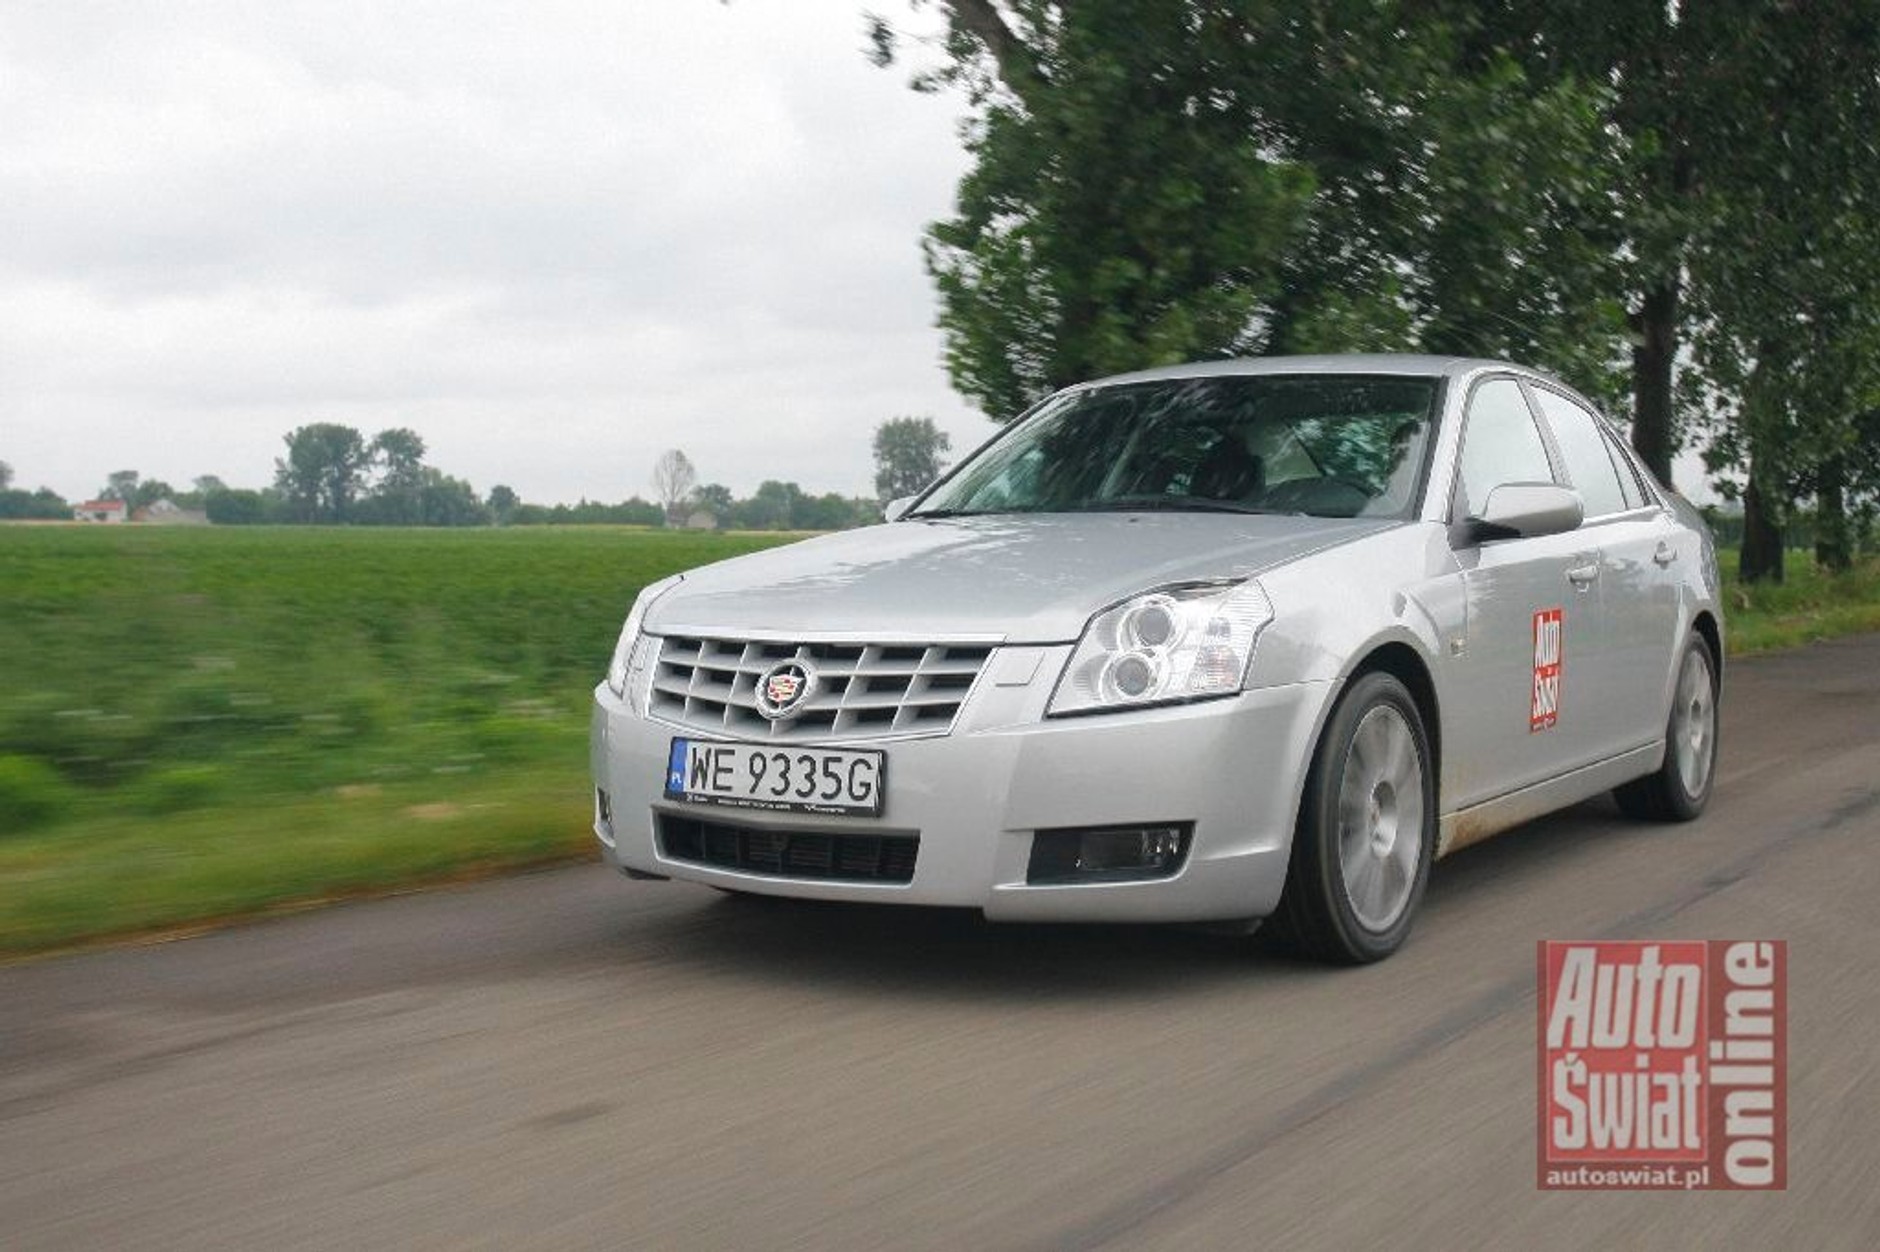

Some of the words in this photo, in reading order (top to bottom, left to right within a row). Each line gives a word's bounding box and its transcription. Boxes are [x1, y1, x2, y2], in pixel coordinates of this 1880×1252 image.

[1534, 611, 1560, 668] Auto
[671, 773, 682, 784] PL
[690, 747, 735, 791] WE
[749, 752, 873, 802] 9335G
